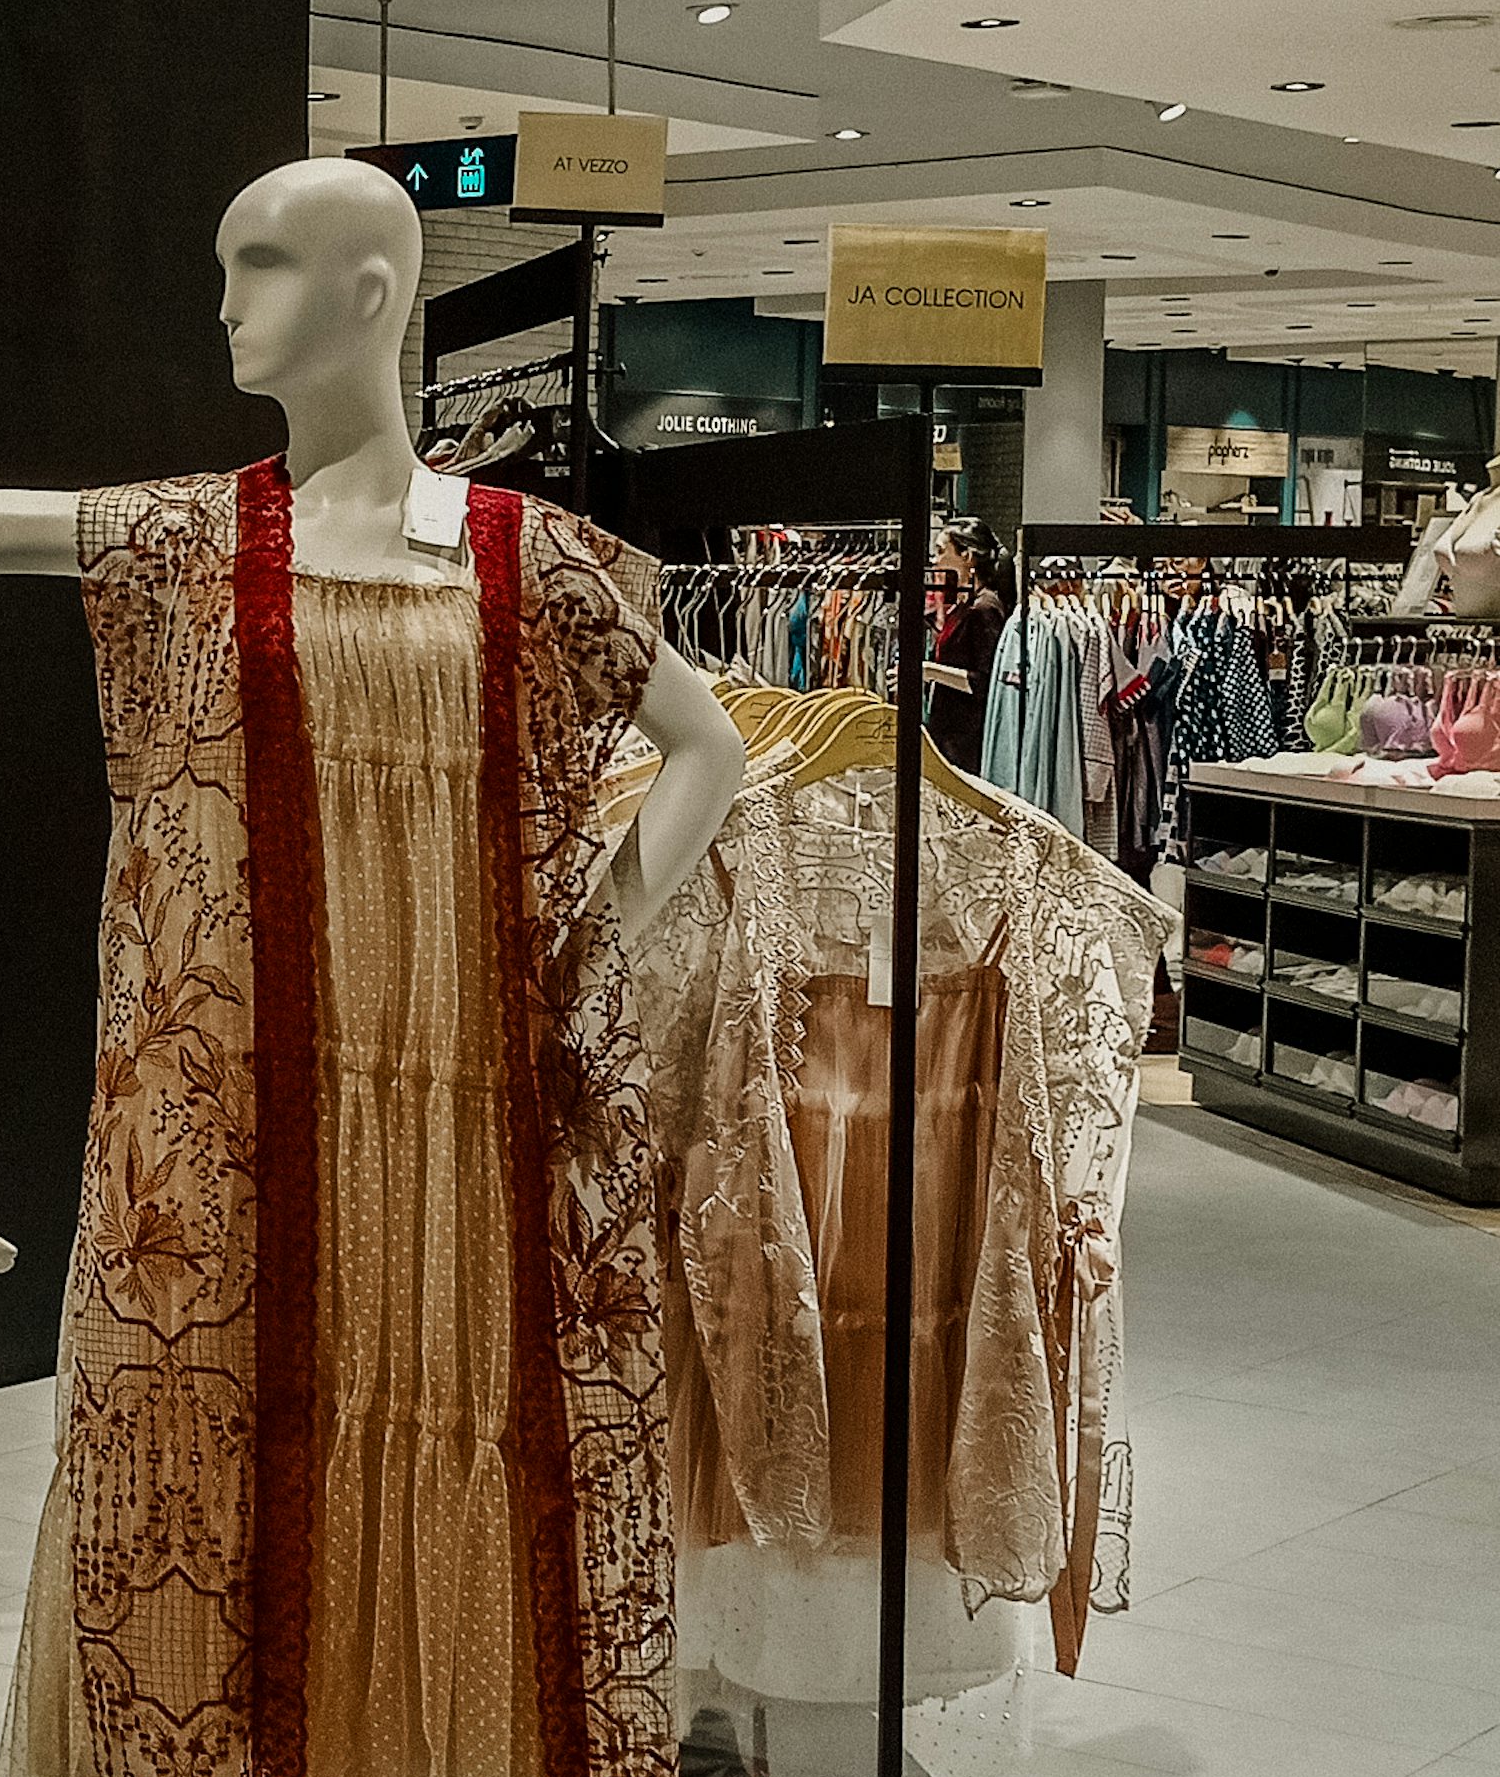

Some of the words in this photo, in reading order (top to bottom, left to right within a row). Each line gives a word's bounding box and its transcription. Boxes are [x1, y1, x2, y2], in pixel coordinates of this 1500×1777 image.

[553, 156, 573, 171] AT
[579, 157, 628, 174] VEZZO
[848, 285, 876, 305] JA
[885, 286, 1024, 309] COLLECTION
[657, 415, 694, 432] JOLIE
[696, 416, 757, 435] CLOTHING
